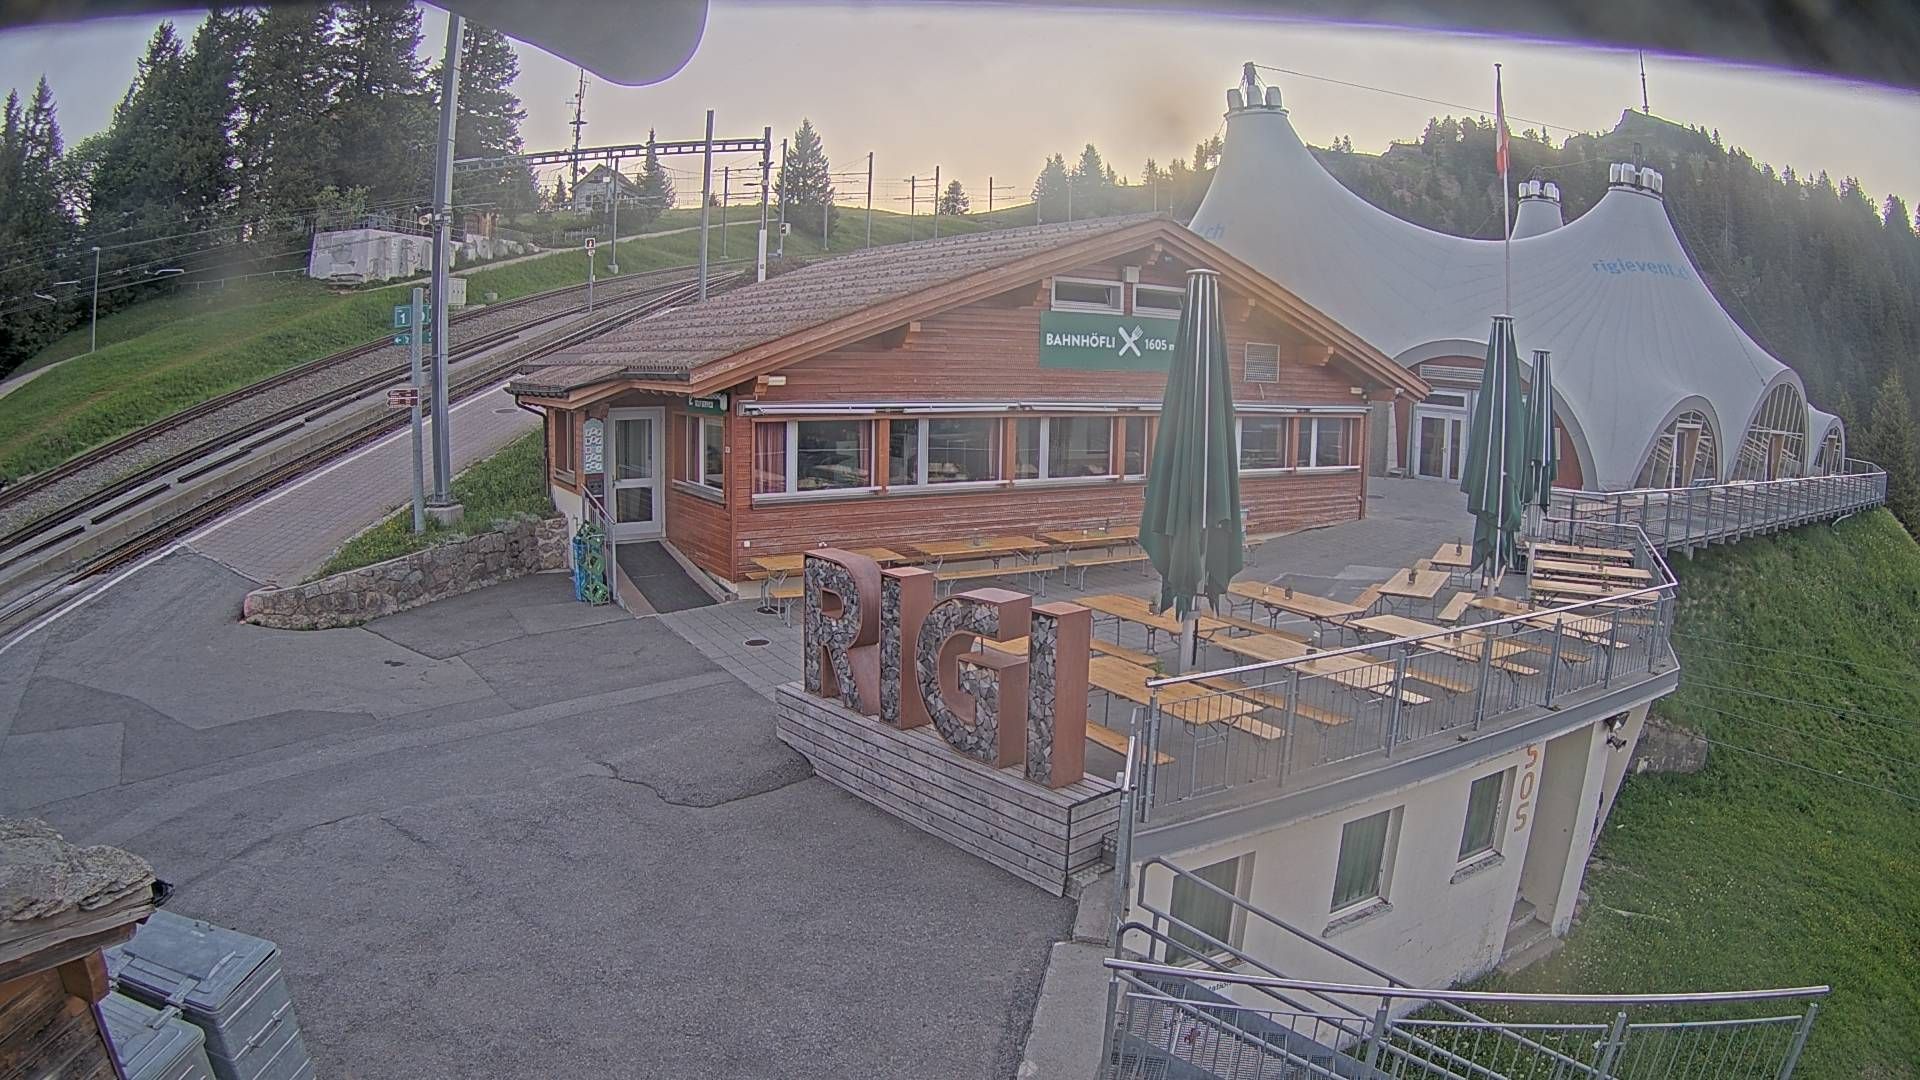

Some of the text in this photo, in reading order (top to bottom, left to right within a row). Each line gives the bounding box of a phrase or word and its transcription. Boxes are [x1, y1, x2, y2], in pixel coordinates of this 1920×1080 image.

[400, 312, 406, 324] 1
[1046, 332, 1116, 349] BAHNHÖFLI
[1144, 338, 1168, 351] 1605
[803, 549, 1091, 790] RIGI
[1513, 742, 1539, 833] SOS
